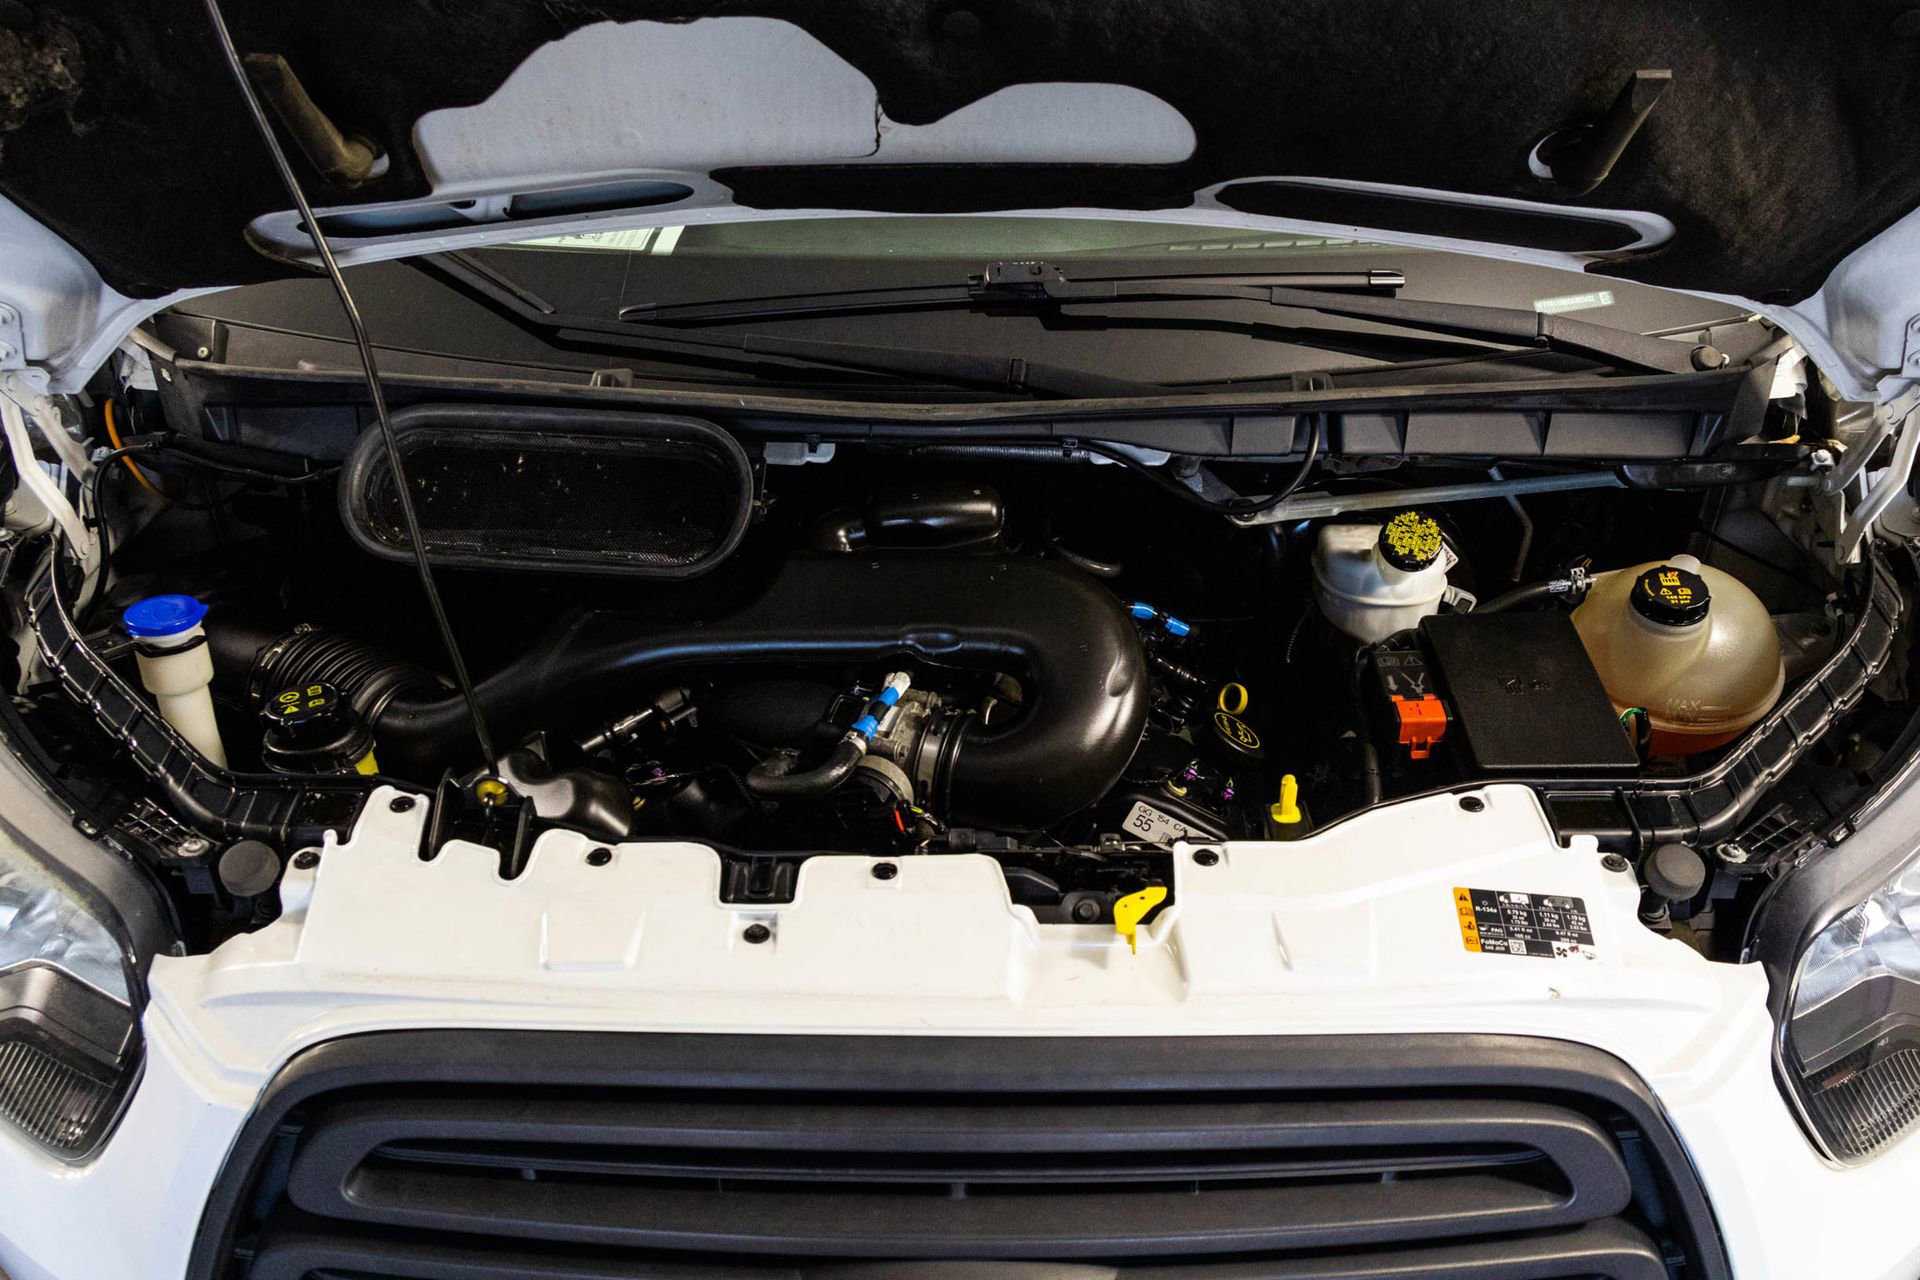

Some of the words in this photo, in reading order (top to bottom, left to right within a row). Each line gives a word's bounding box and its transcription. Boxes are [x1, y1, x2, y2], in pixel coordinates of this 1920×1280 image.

[1138, 805, 1153, 817] GG
[1133, 815, 1154, 832] 55
[1475, 905, 1498, 913] R-134a
[1481, 938, 1509, 946] FoMoCo
